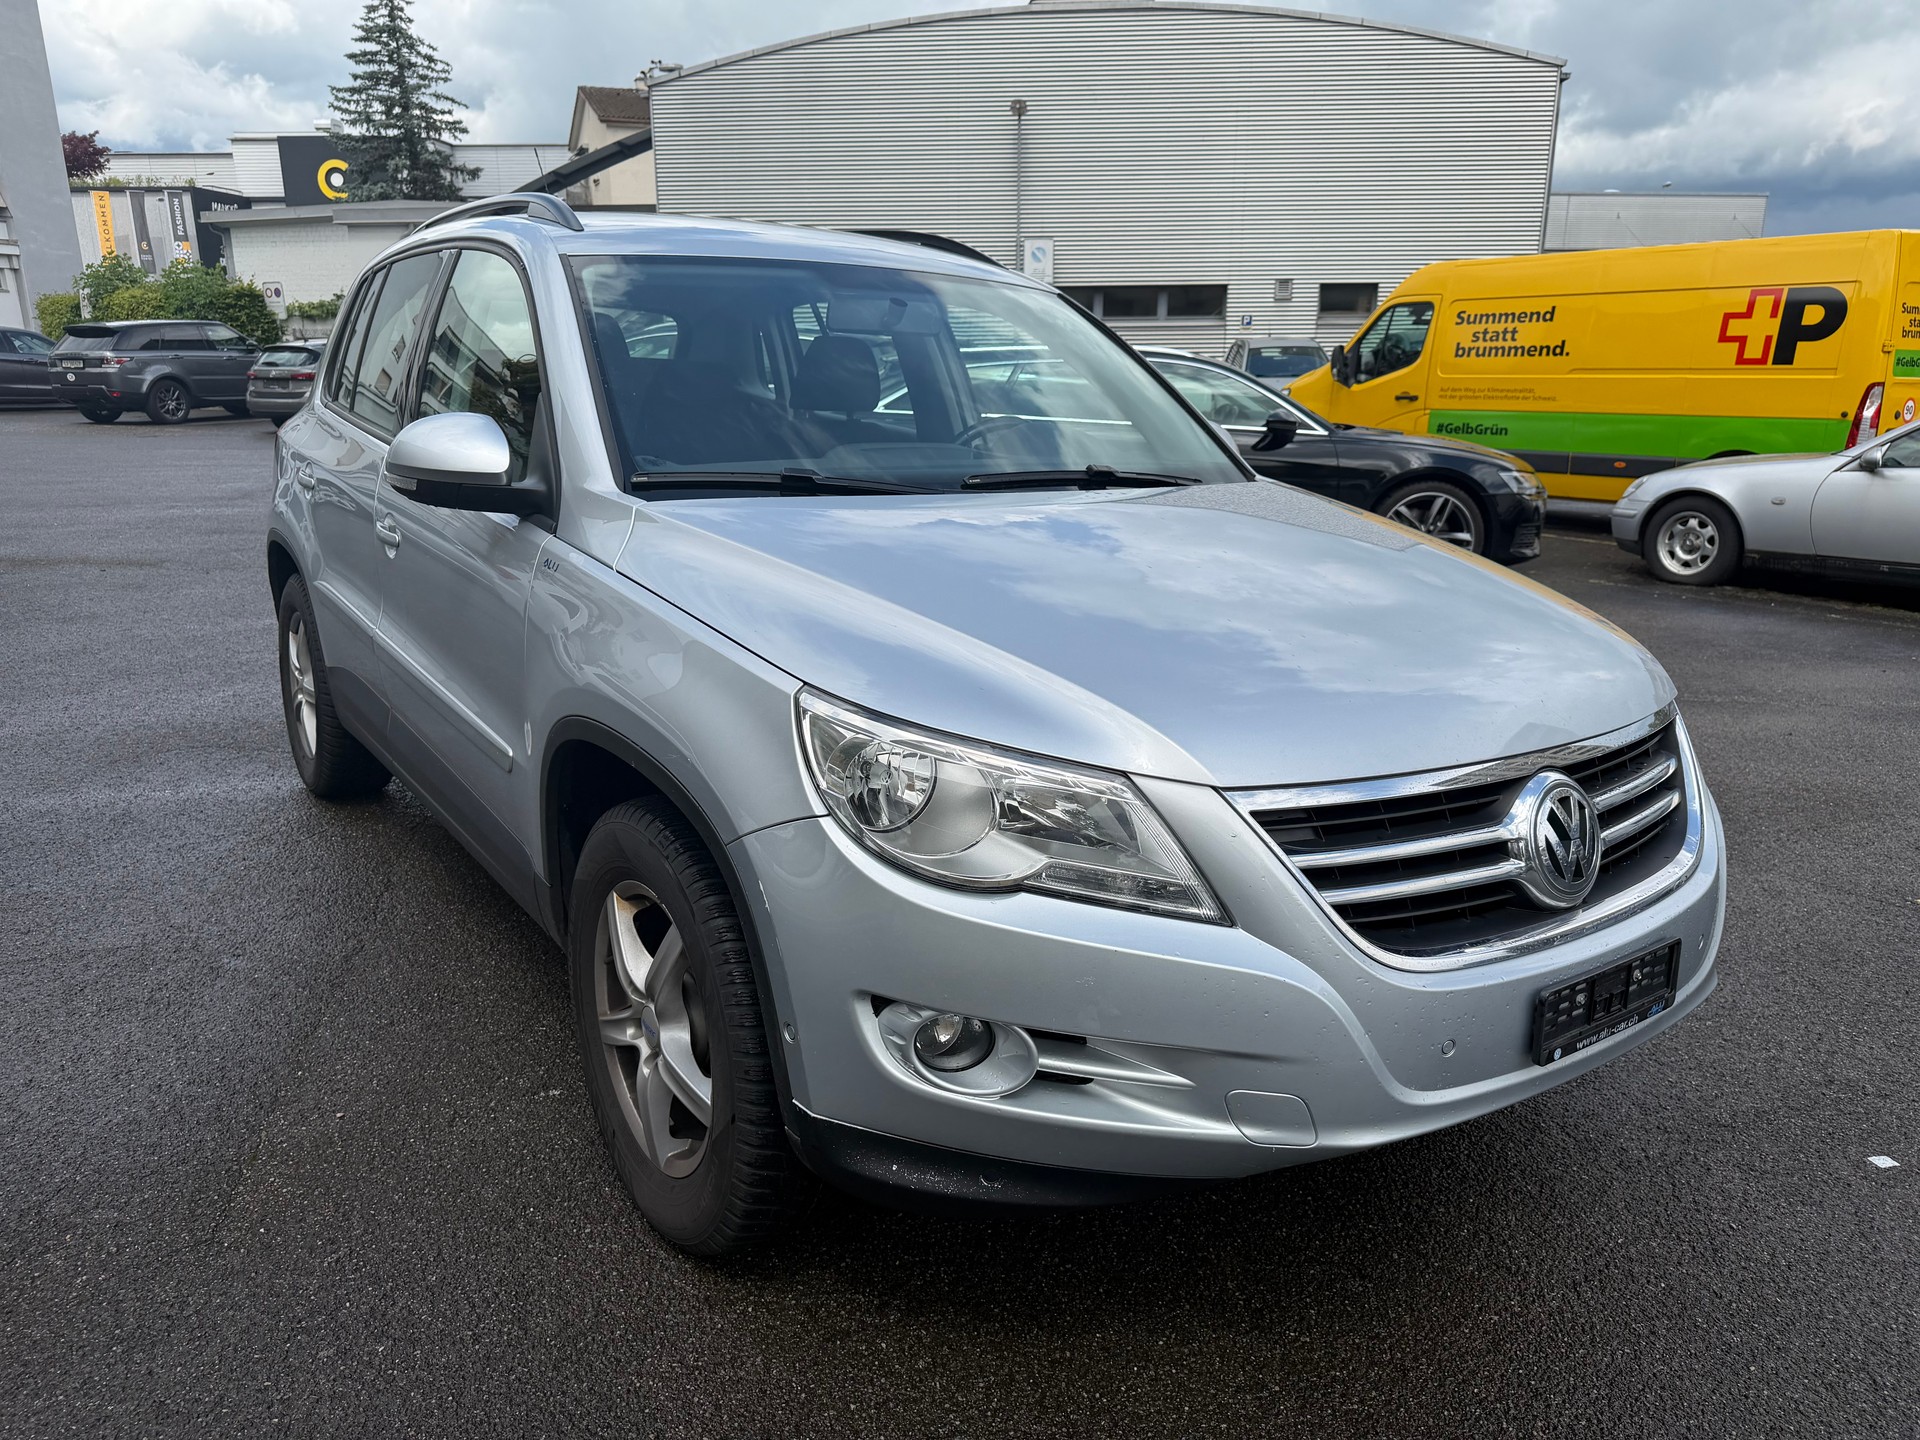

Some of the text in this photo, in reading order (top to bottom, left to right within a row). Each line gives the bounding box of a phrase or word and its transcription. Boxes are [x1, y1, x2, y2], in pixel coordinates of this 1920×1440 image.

[173, 198, 185, 235] FASHION
[98, 195, 114, 262] LKOMMEN
[1455, 305, 1557, 326] Summend
[1771, 286, 1848, 366] P
[1471, 326, 1519, 343] statt
[1454, 340, 1570, 358] brummend.
[1905, 405, 1914, 415] 90
[1436, 422, 1508, 436] #GelbGrün
[1576, 1013, 1639, 1051] www.alu-car.ch
